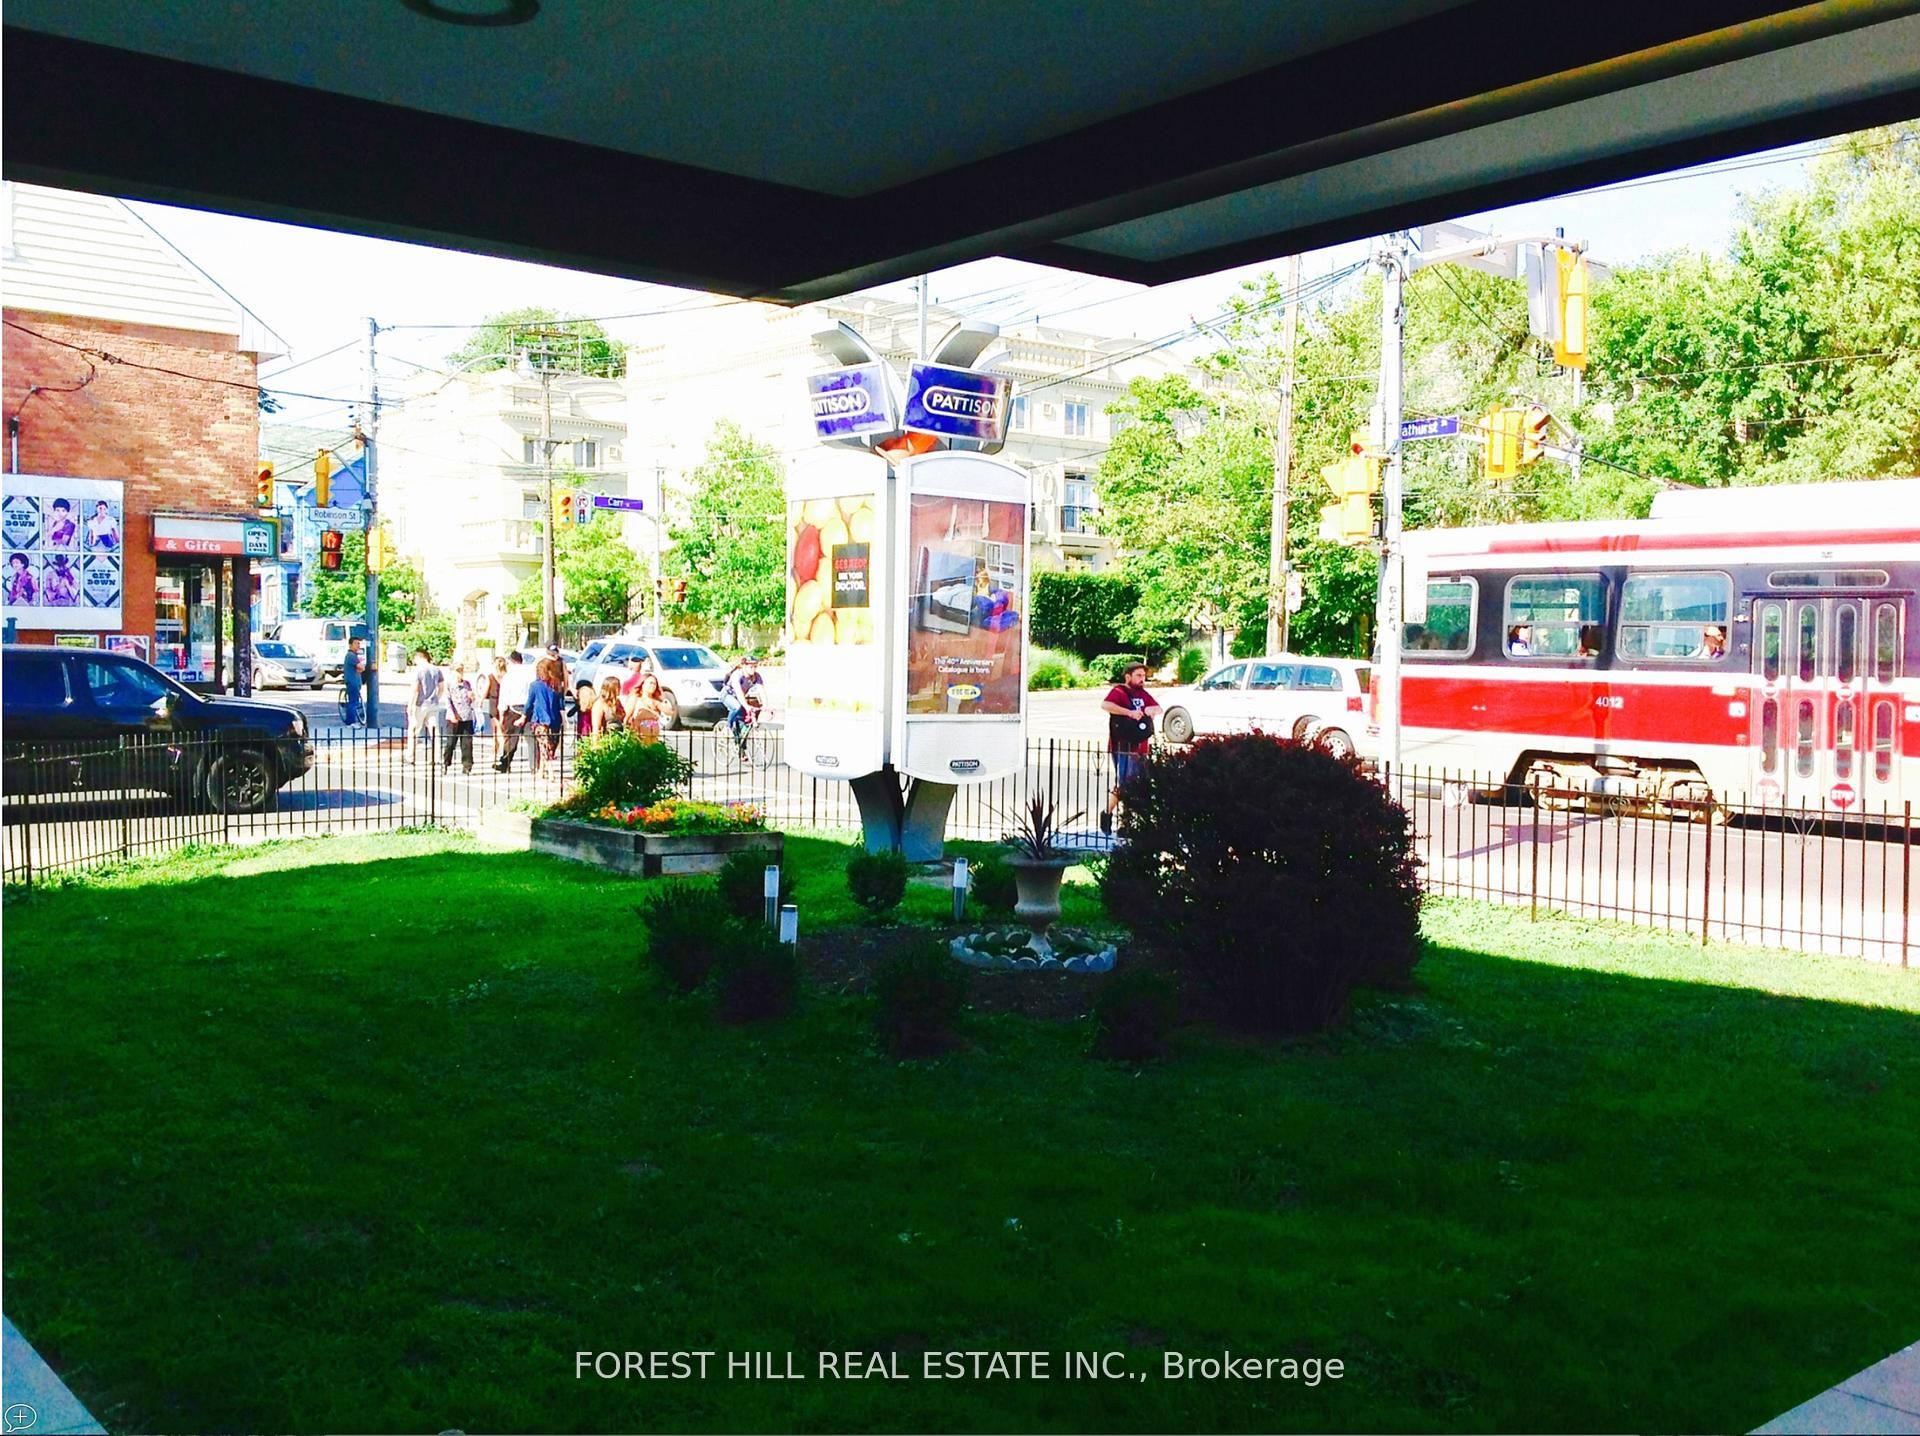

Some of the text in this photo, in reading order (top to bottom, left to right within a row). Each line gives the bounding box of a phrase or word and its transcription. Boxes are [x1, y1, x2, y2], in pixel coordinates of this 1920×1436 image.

[1401, 421, 1438, 436] athurst
[10, 513, 30, 521] GET
[314, 509, 356, 520] Robinson St
[165, 540, 221, 552] & Gifts
[960, 658, 994, 667] Anniversary
[938, 665, 969, 674] Catalogue
[1595, 695, 1624, 709] 4012
